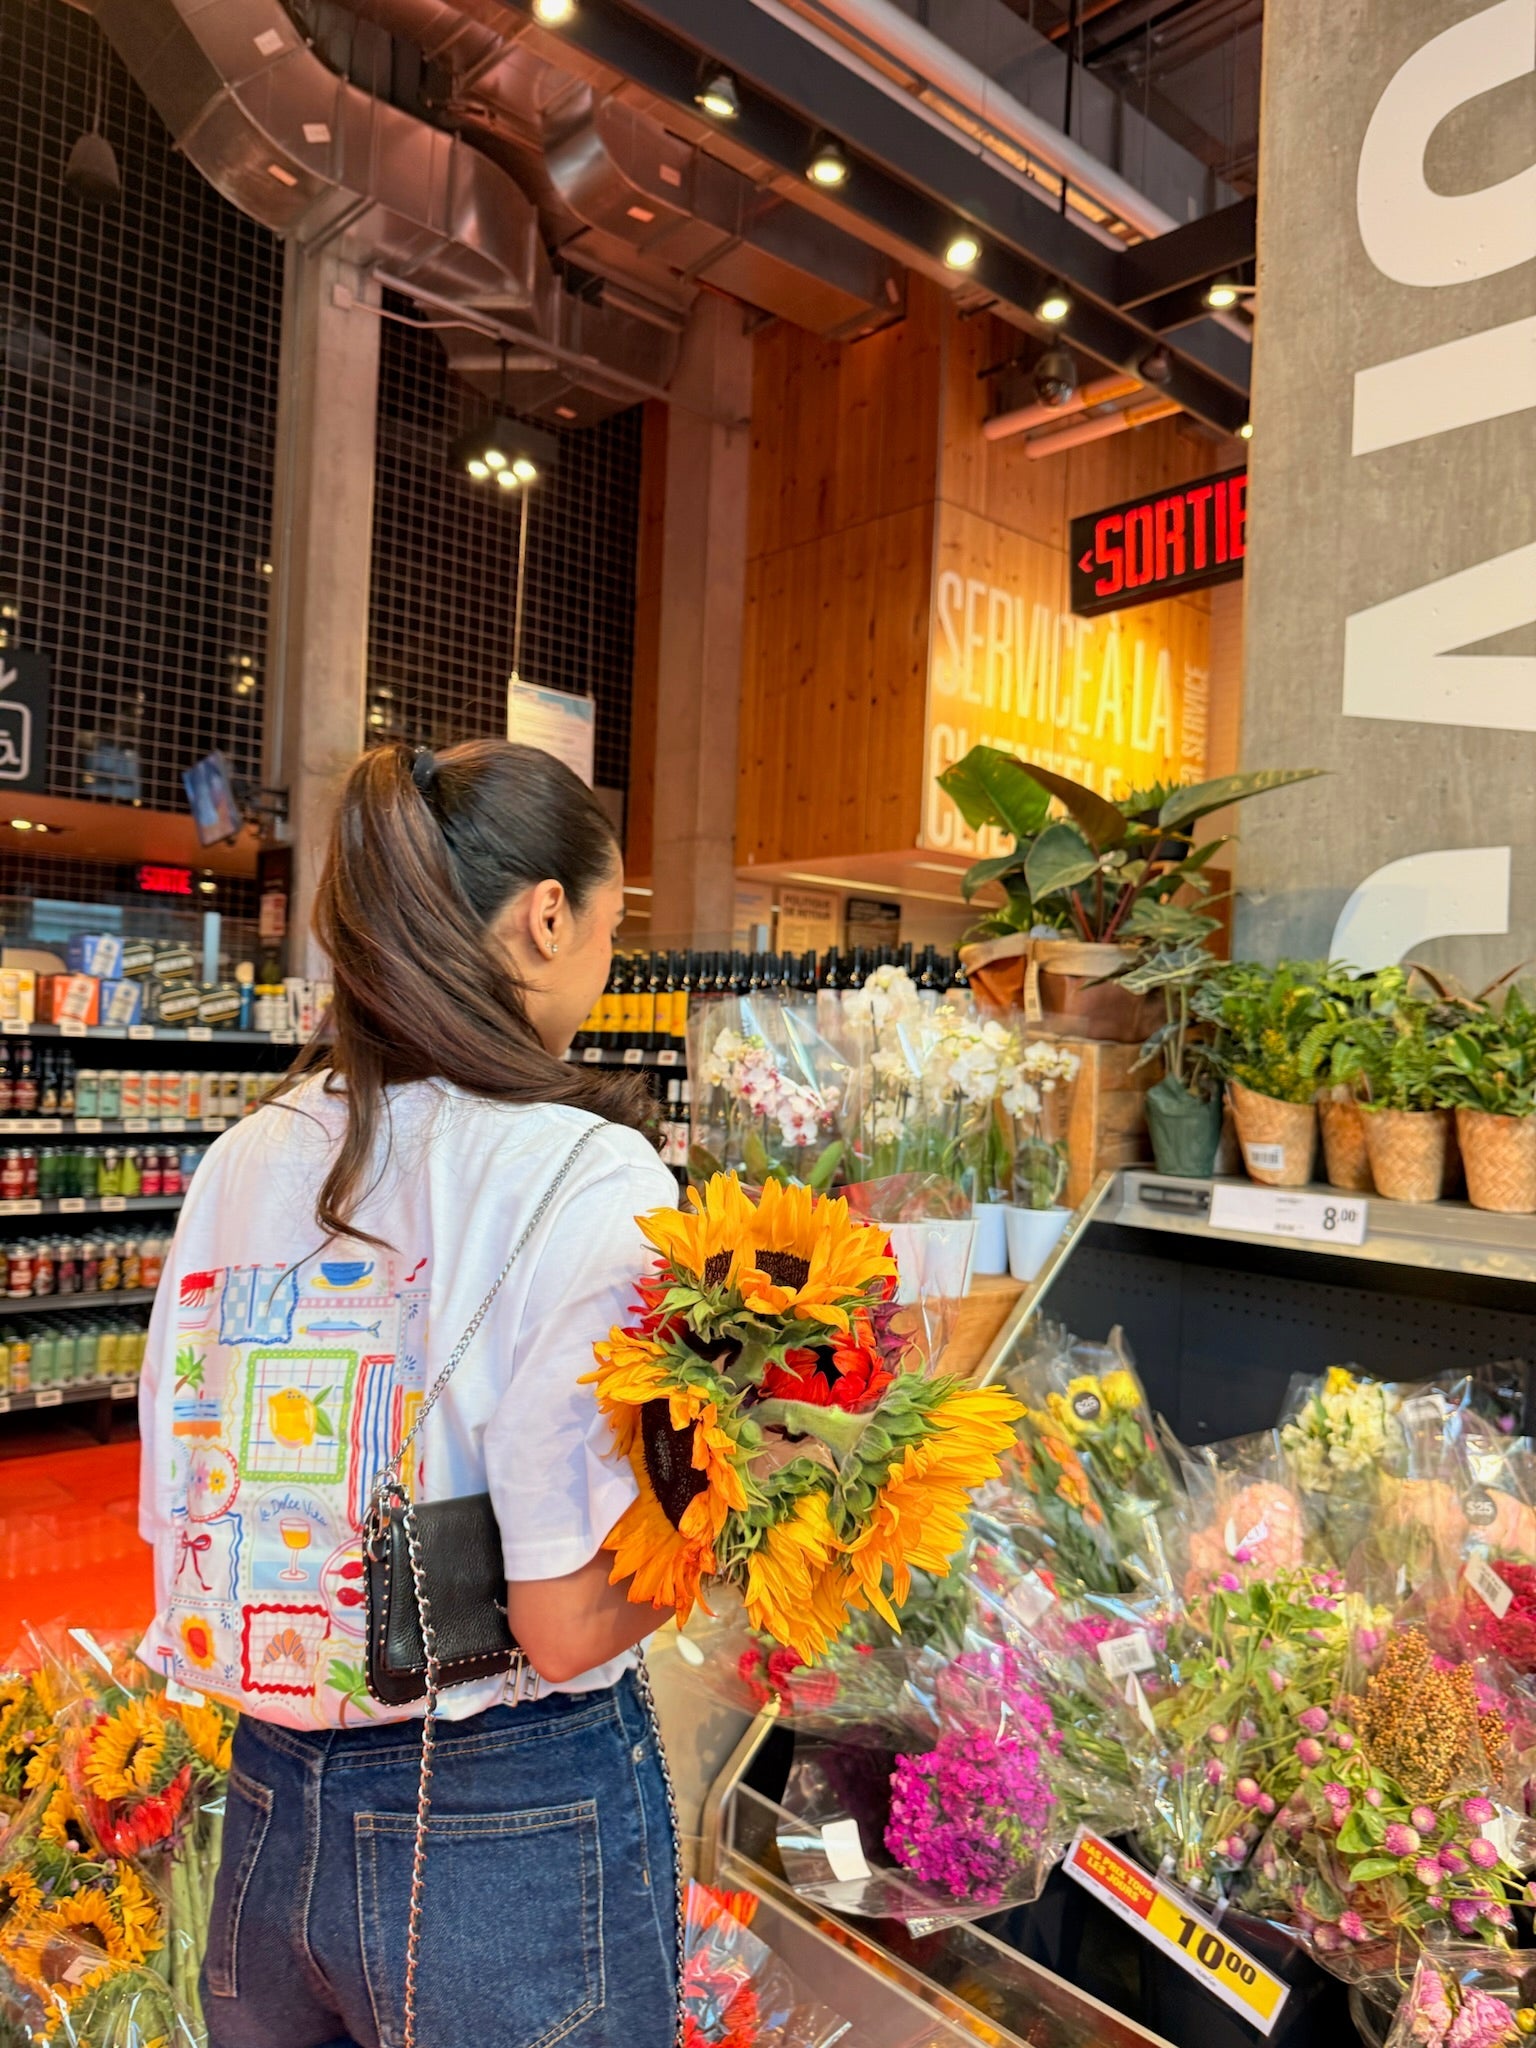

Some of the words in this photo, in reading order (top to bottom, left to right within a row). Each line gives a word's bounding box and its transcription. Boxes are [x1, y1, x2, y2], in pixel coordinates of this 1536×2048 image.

[1095, 474, 1247, 598] SORTIE
[936, 571, 1094, 733] SERVICE
[1131, 640, 1175, 759] LA
[1181, 660, 1209, 762] SERVICE
[1075, 1396, 1098, 1416] $25
[1466, 1500, 1494, 1516] $25
[1080, 1840, 1103, 1861] BAS
[1102, 1856, 1128, 1880] PRIX
[1127, 1874, 1154, 1902] TOUS
[1086, 1856, 1107, 1877] LES
[1106, 1873, 1140, 1903] JOURS
